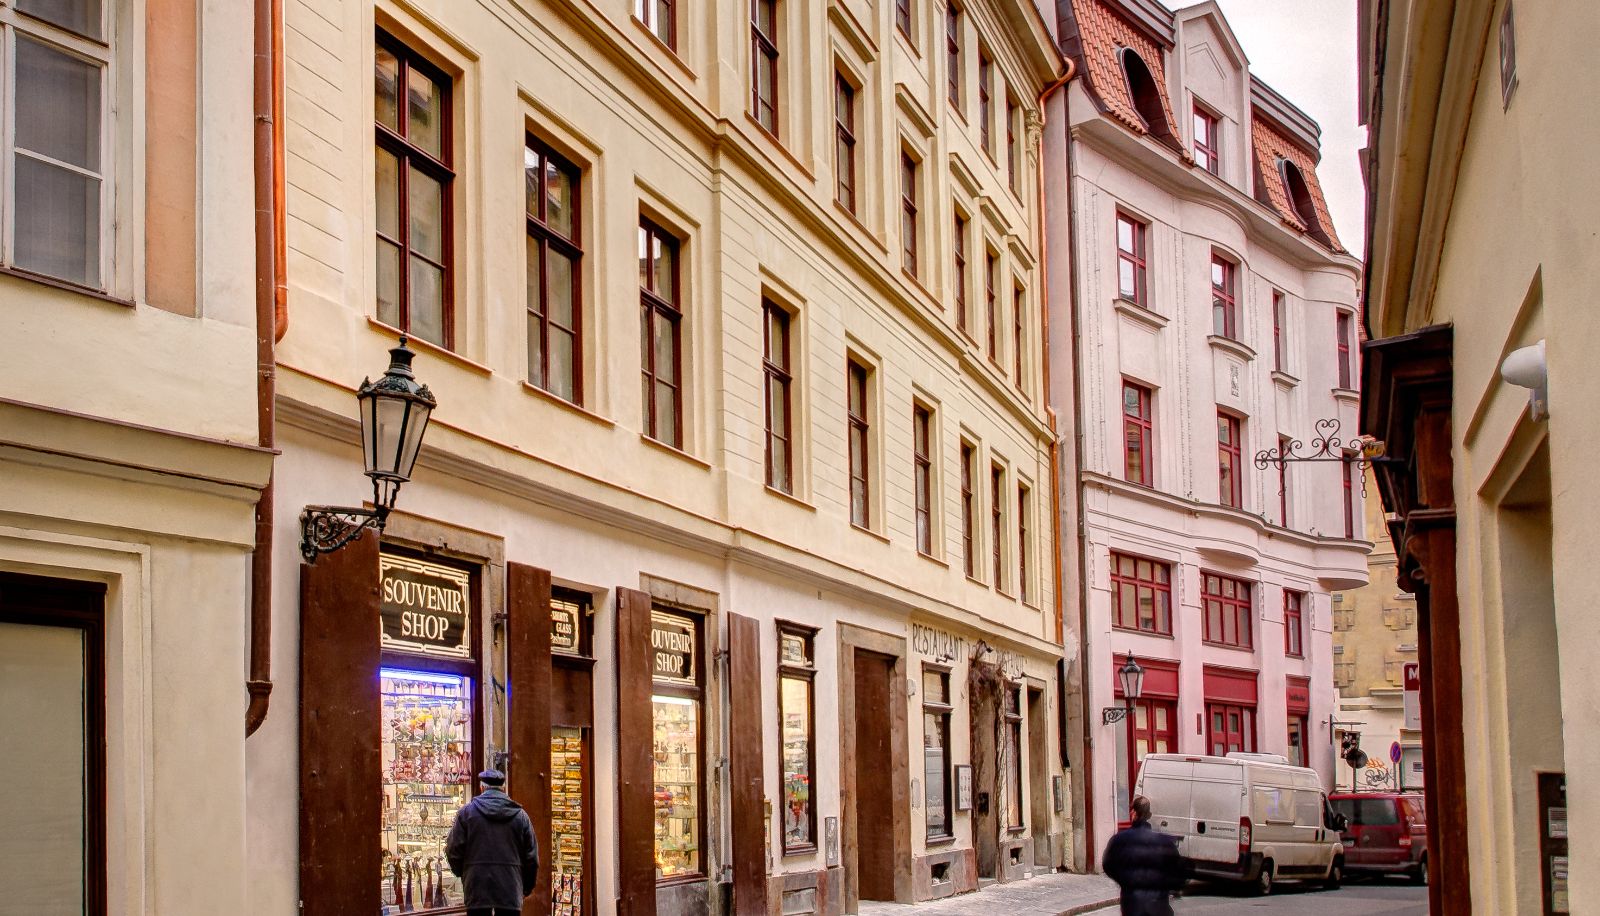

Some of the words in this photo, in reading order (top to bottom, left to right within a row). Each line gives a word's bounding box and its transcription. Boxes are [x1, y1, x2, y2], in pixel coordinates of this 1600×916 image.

[383, 576, 462, 614] SOUVENIR
[401, 611, 449, 640] SHOP
[651, 628, 691, 653] OUVENIR
[912, 622, 964, 663] RESTAURANT
[656, 652, 683, 673] SHOP
